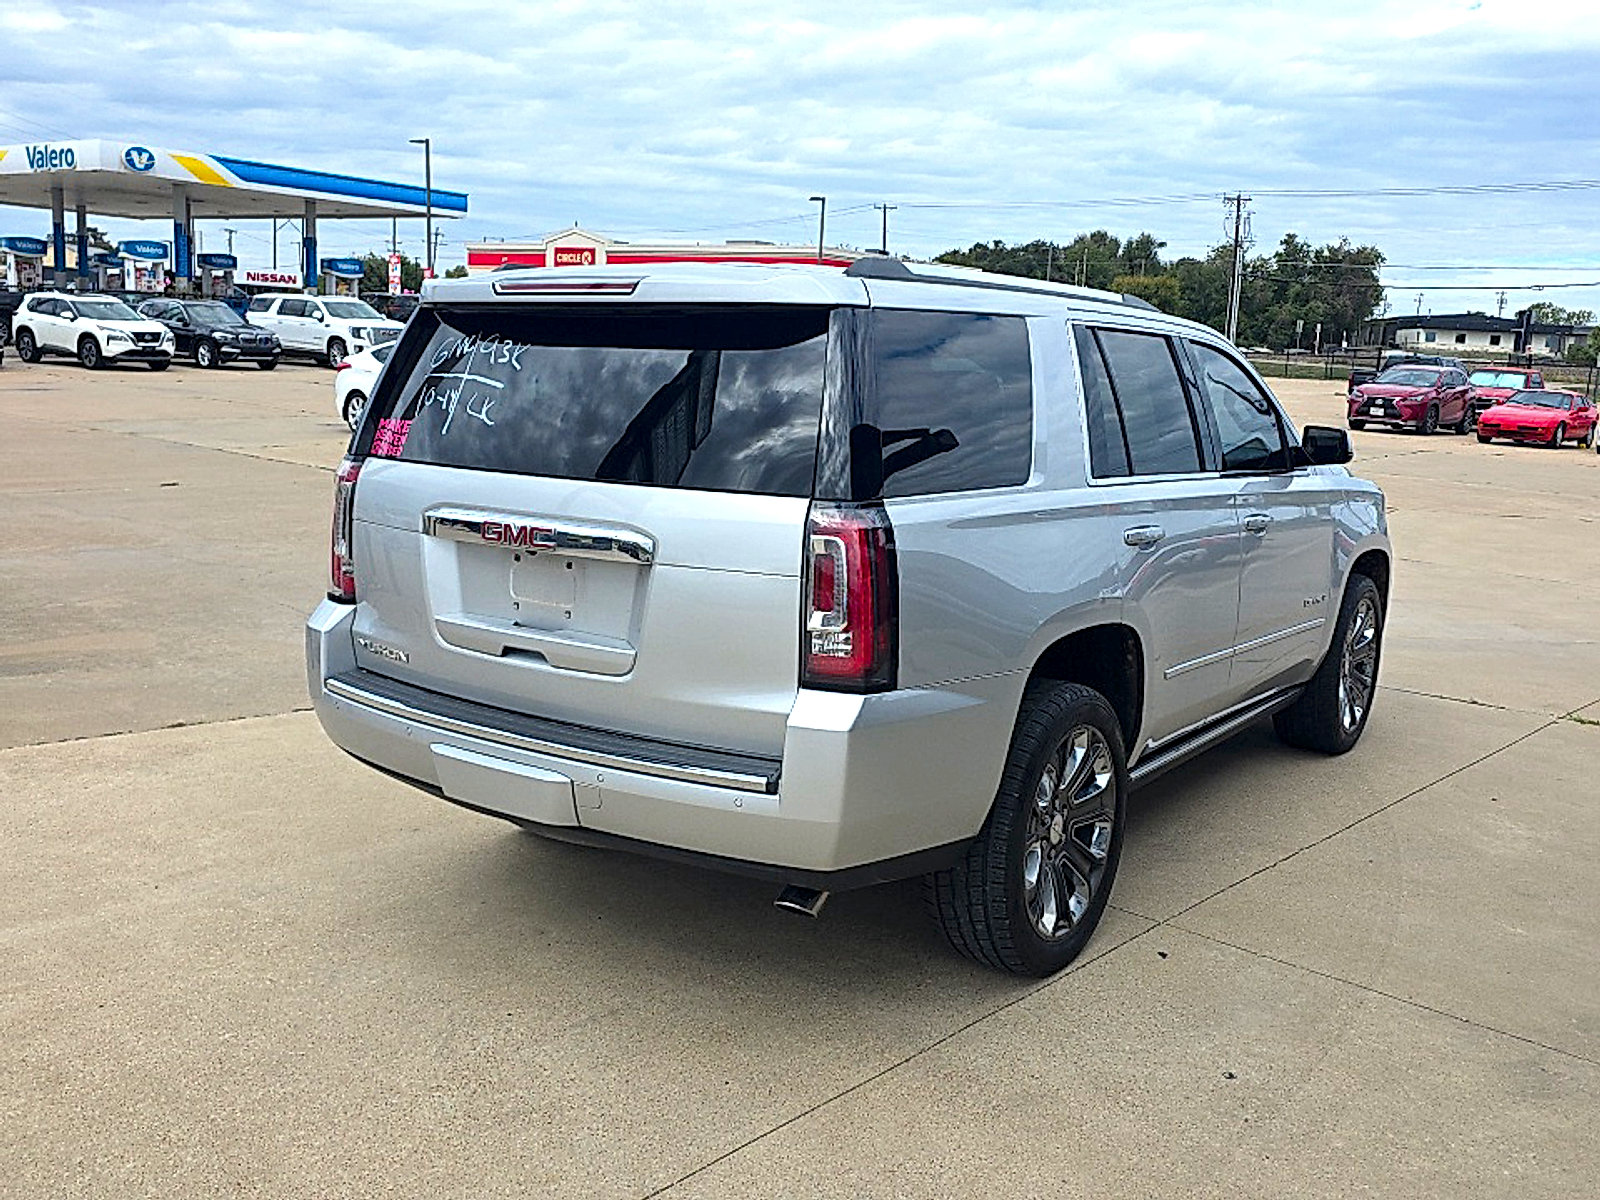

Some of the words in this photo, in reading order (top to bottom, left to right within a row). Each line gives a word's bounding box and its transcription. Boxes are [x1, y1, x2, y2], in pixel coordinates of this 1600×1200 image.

[25, 144, 75, 169] Valero
[136, 244, 163, 255] Valero
[556, 253, 581, 263] CIRCLE
[246, 271, 298, 285] NISSAN
[480, 520, 557, 549] GMC
